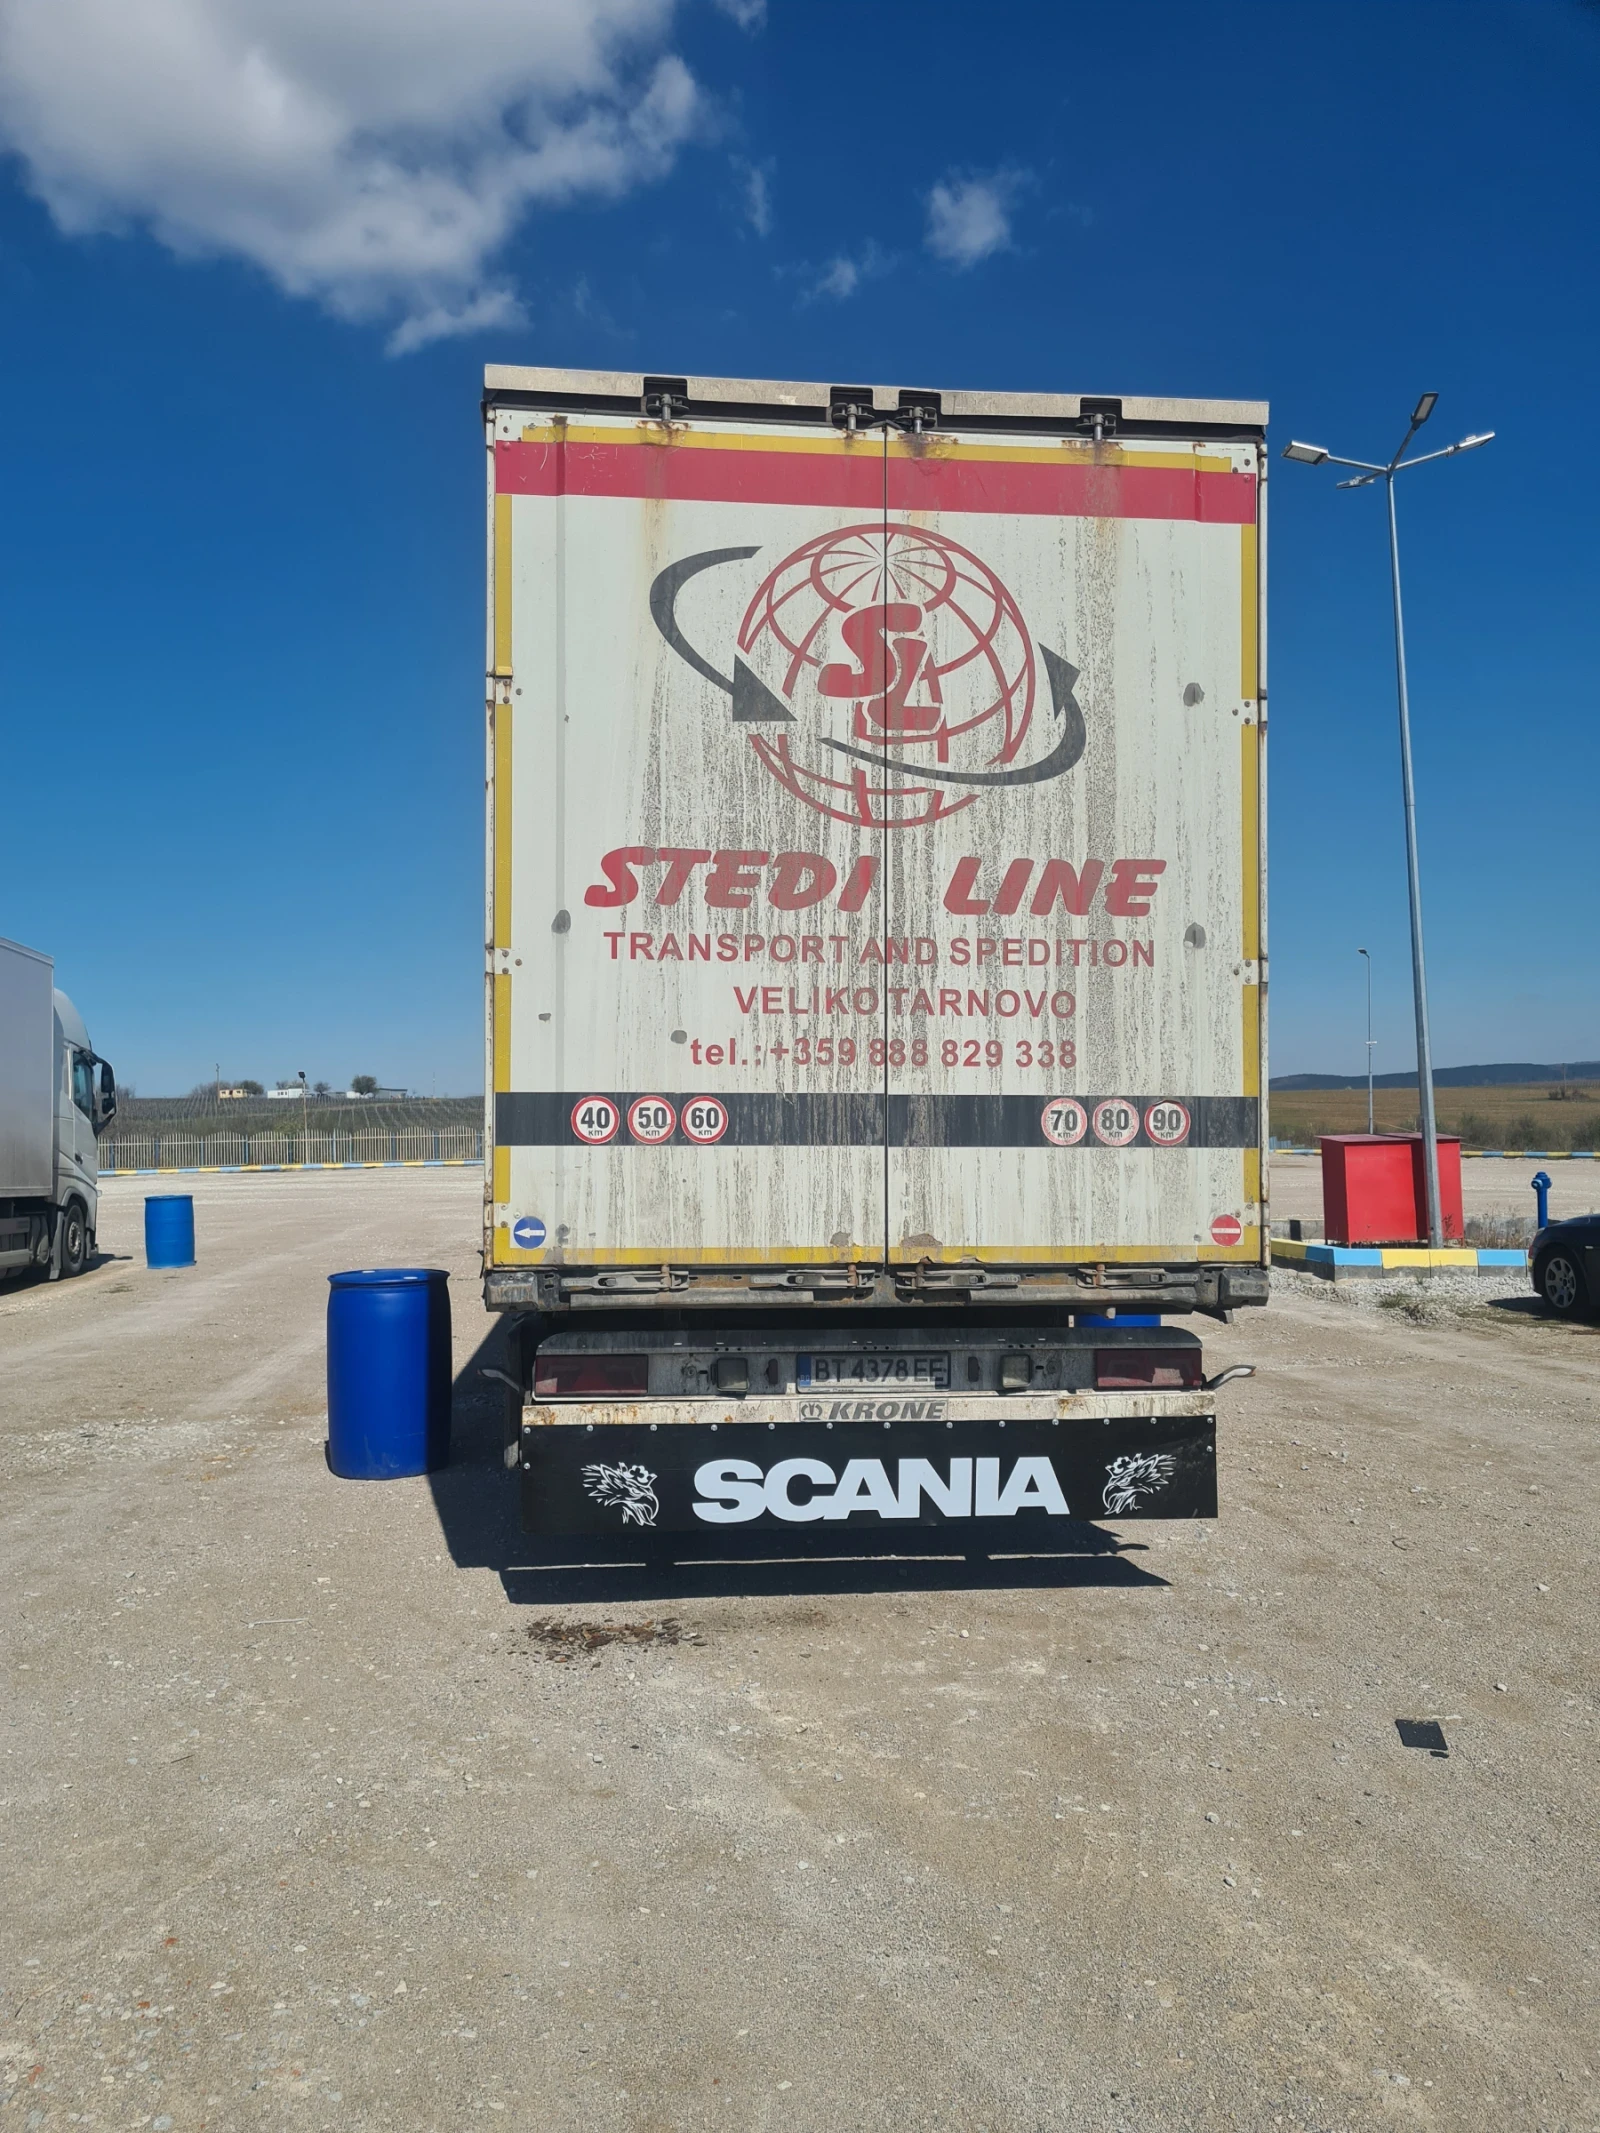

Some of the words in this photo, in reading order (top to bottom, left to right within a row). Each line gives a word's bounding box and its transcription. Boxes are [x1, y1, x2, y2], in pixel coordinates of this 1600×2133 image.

[584, 846, 881, 912] STEDI
[943, 856, 1167, 917] LINE
[603, 931, 849, 964] TRANSPORT
[859, 936, 938, 965] AND
[950, 938, 1155, 967] SPEDITION
[733, 986, 879, 1015] VELIKO
[888, 987, 1077, 1019] TARNOVO
[868, 1039, 928, 1067] 888
[941, 1040, 1004, 1067] 829
[1015, 1041, 1078, 1068] 338
[580, 1107, 611, 1129] 40
[638, 1107, 667, 1128] 50
[691, 1107, 719, 1129] 60
[1051, 1109, 1078, 1131] 70
[1101, 1109, 1130, 1131] 80
[1153, 1109, 1182, 1131] 90
[815, 1358, 846, 1383] BT
[851, 1358, 909, 1383] 4378
[913, 1358, 945, 1383] EE
[828, 1401, 946, 1420] KRONE
[692, 1456, 1070, 1523] SCANIA
